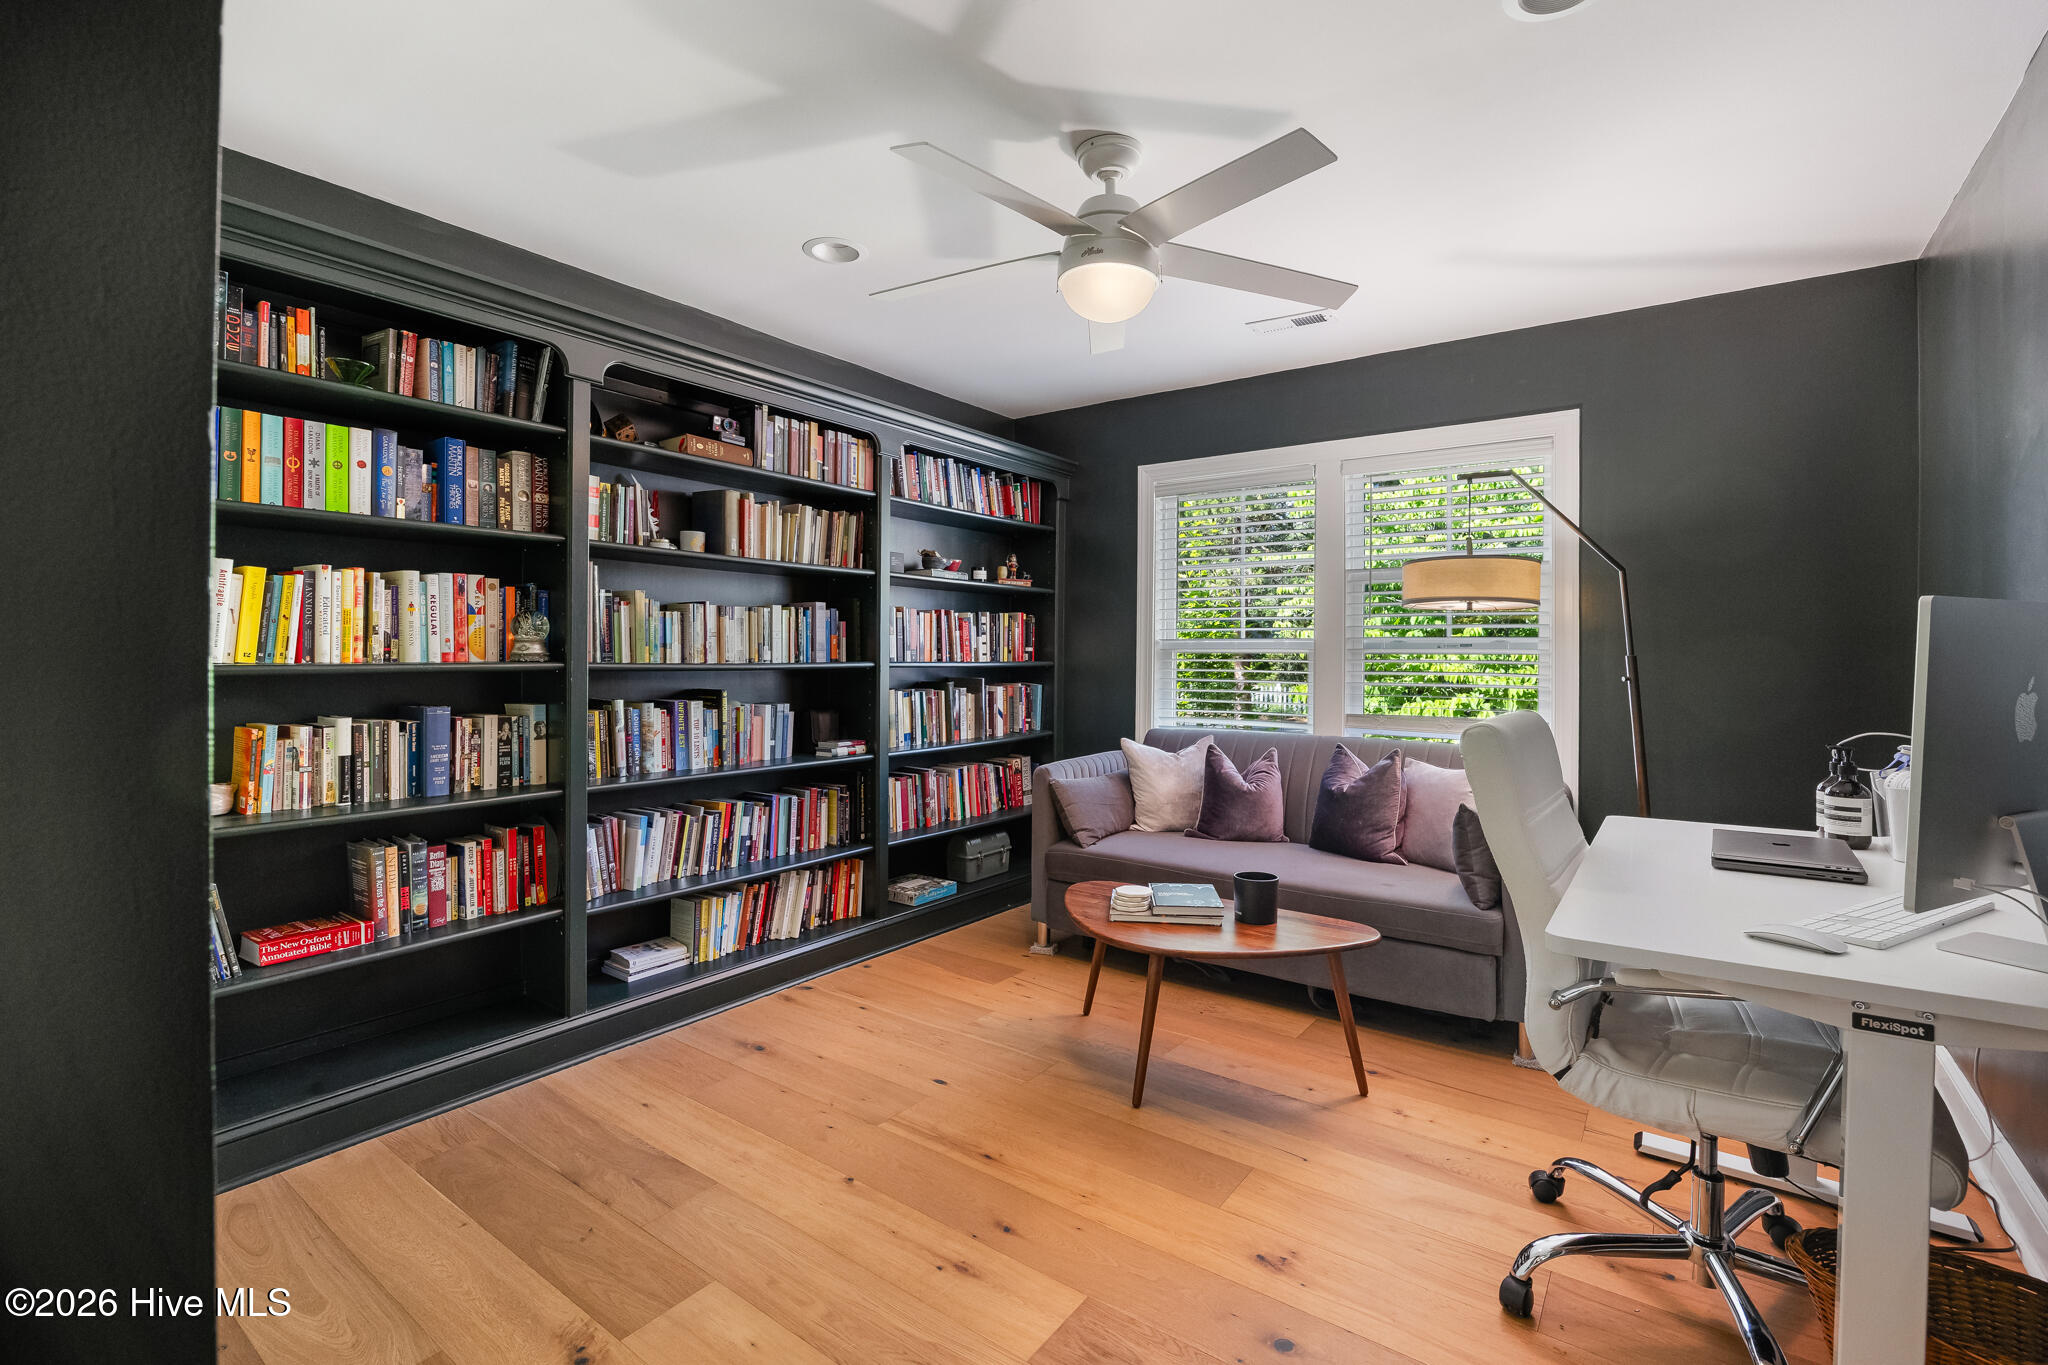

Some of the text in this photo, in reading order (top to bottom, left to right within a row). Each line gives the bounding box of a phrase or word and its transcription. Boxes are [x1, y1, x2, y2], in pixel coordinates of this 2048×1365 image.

[448, 444, 457, 476] MARTIN
[216, 569, 228, 606] Antifragile
[322, 596, 330, 635] Educated
[429, 852, 444, 860] Berlin
[387, 852, 396, 890] INFIDEL
[376, 880, 384, 897] Across
[400, 886, 410, 911] REFUGEE
[260, 944, 279, 954] The
[279, 938, 299, 951] New
[300, 933, 332, 946] Oxford
[260, 943, 332, 963] Annotated Bible
[1861, 1017, 1925, 1036] FlexiSpot
